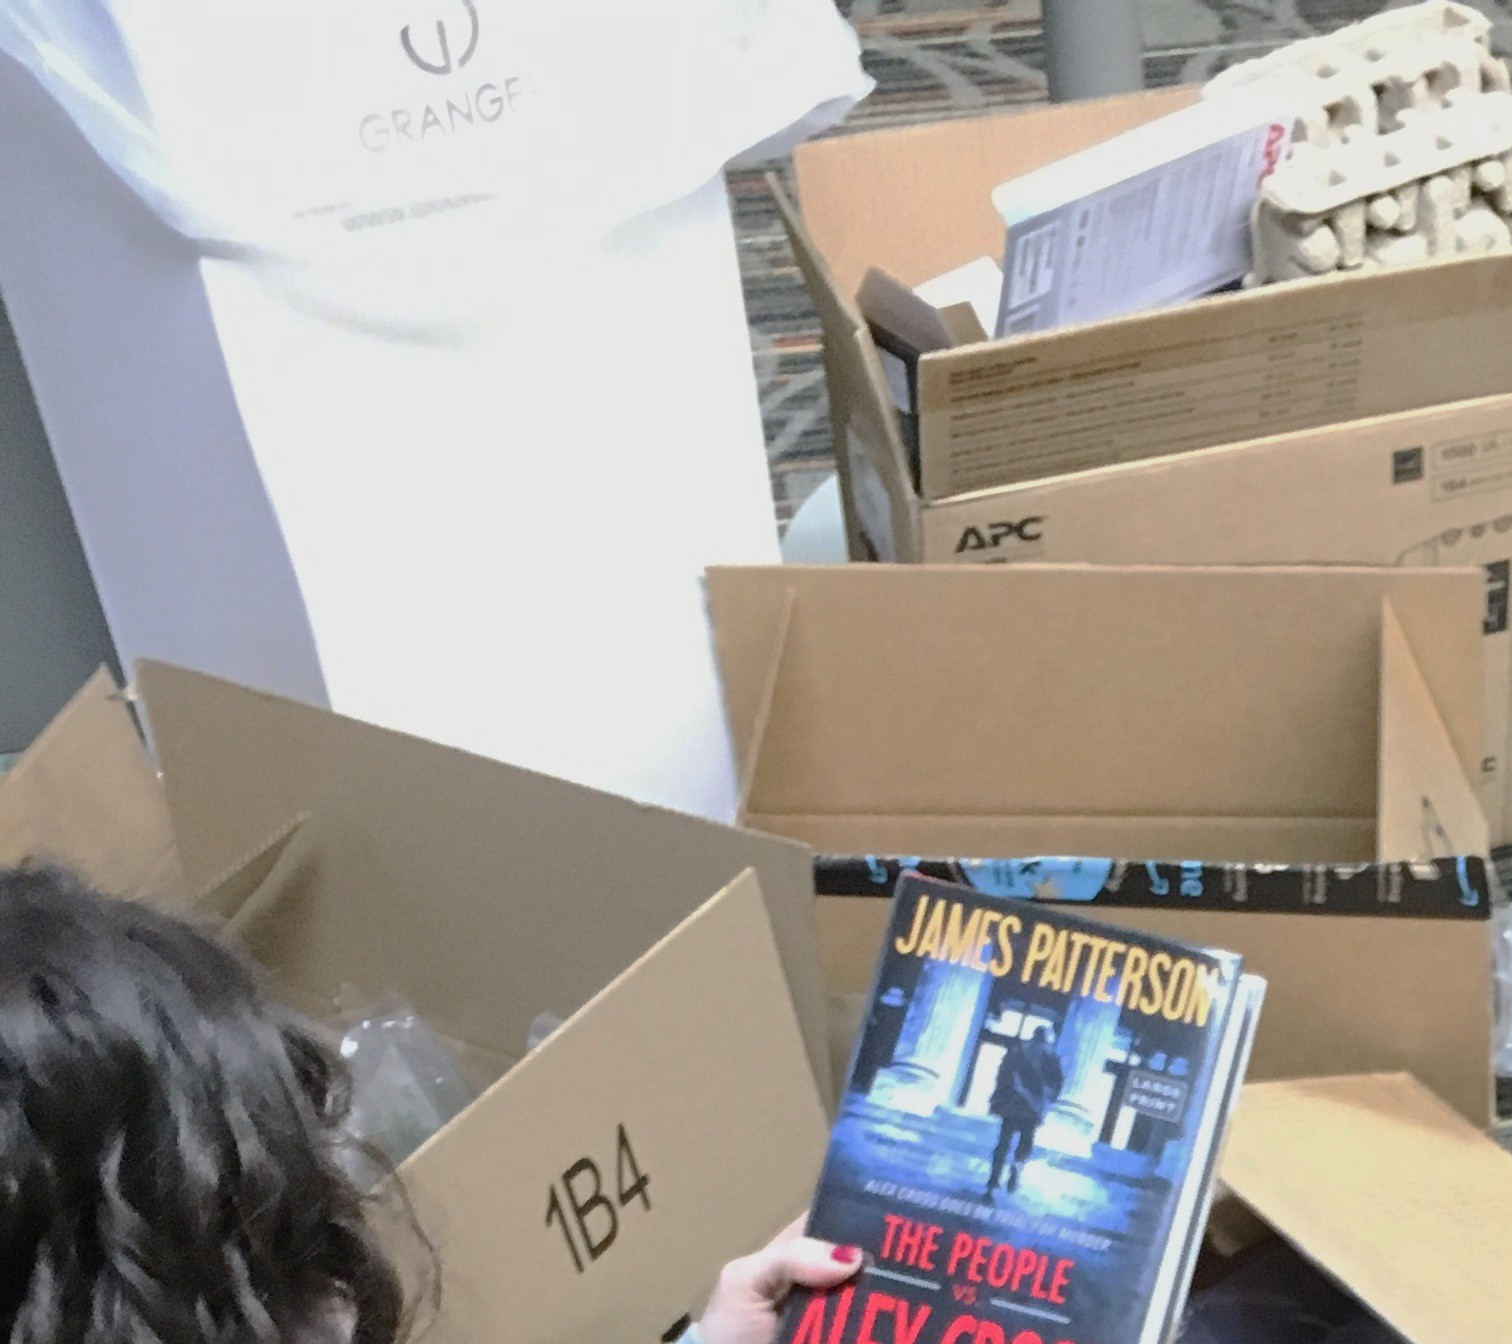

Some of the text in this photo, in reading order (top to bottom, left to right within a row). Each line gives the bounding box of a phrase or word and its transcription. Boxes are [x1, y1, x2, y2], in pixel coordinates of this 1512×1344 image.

[954, 515, 1045, 553] APC
[895, 894, 1219, 1027] JAMES PATTERSON
[546, 1122, 652, 1273] 1B4
[881, 1214, 1075, 1305] THE PEOPLE
